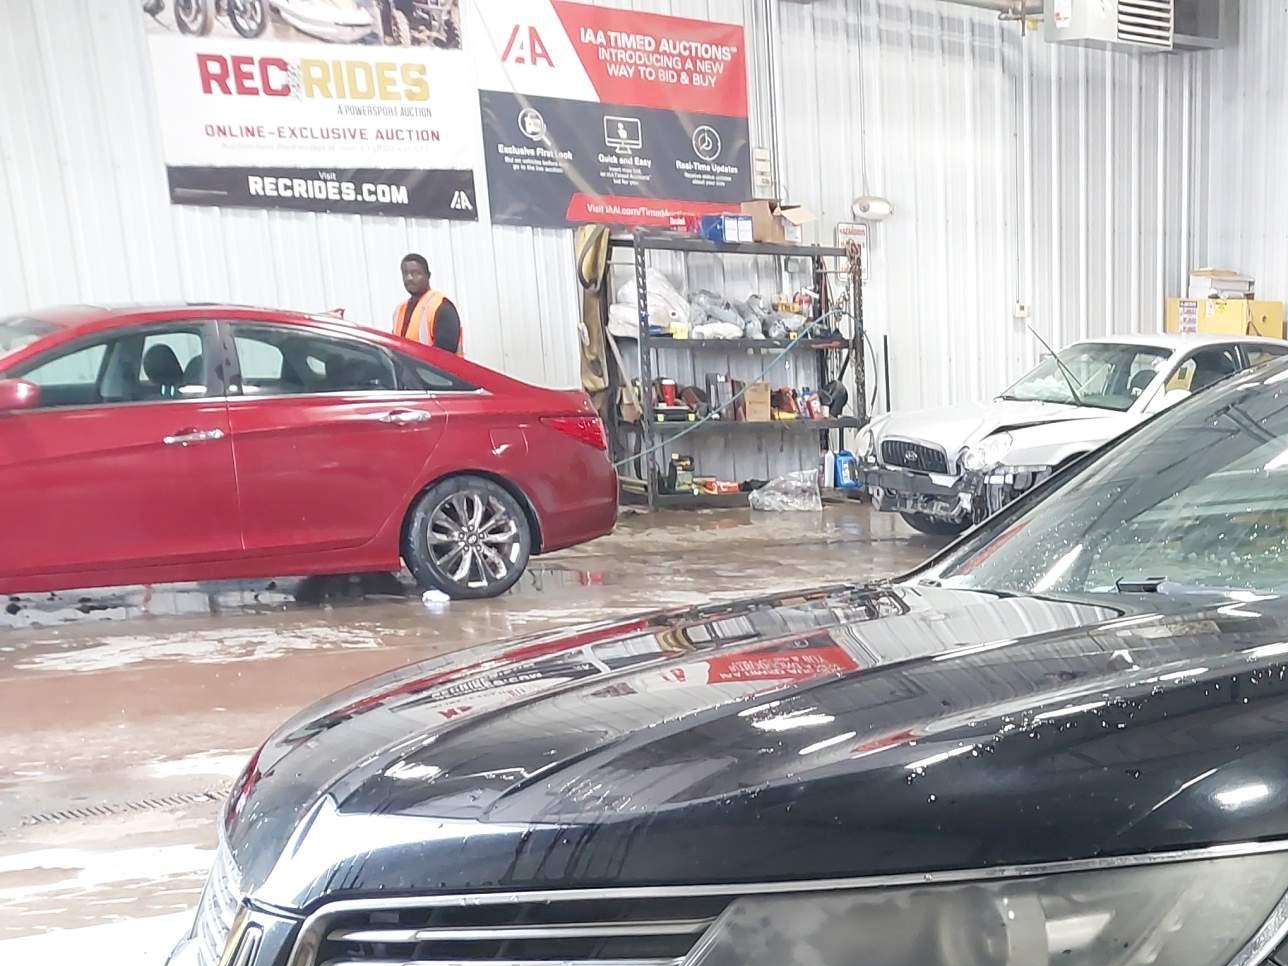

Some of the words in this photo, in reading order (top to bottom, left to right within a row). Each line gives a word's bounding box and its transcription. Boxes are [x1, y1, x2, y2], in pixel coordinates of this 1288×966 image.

[580, 27, 606, 46] IAA
[607, 31, 656, 51] TIMED
[598, 48, 682, 69] INTRODUCING
[685, 58, 694, 71] A
[697, 61, 724, 74] NEW
[197, 53, 292, 96] REC
[301, 58, 431, 102] RIDES
[607, 63, 635, 77] WAY
[638, 66, 656, 80] TO
[658, 70, 677, 83] BID
[680, 72, 689, 85] &
[693, 73, 717, 87] BUY
[205, 124, 369, 141] ONLINE-EXCLUSIVE
[375, 129, 441, 142] AUCTION
[598, 153, 618, 164] Quick
[619, 156, 633, 165] and
[634, 157, 651, 168] Easy
[676, 160, 710, 172] Real-Time
[318, 170, 337, 180] Visit
[248, 176, 409, 204] RECRIDES.COM
[586, 204, 603, 214] Visit
